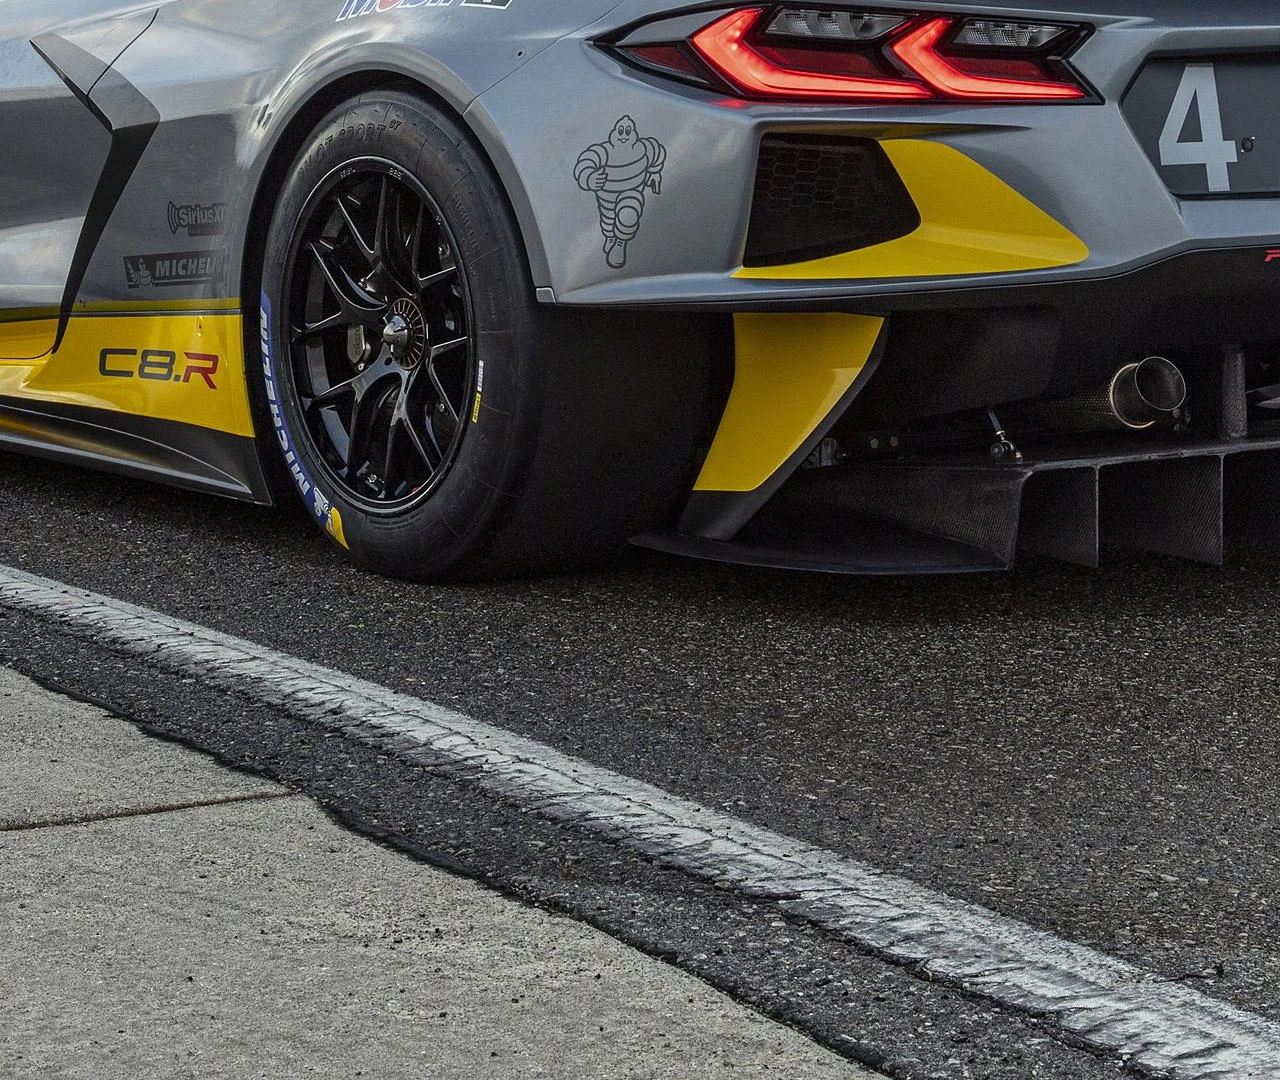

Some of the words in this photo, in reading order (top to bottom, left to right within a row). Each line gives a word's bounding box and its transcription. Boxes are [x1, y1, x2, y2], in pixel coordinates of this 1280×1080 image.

[1158, 62, 1238, 192] 4
[98, 348, 219, 390] C8.R
[259, 310, 311, 496] MICHELIN
